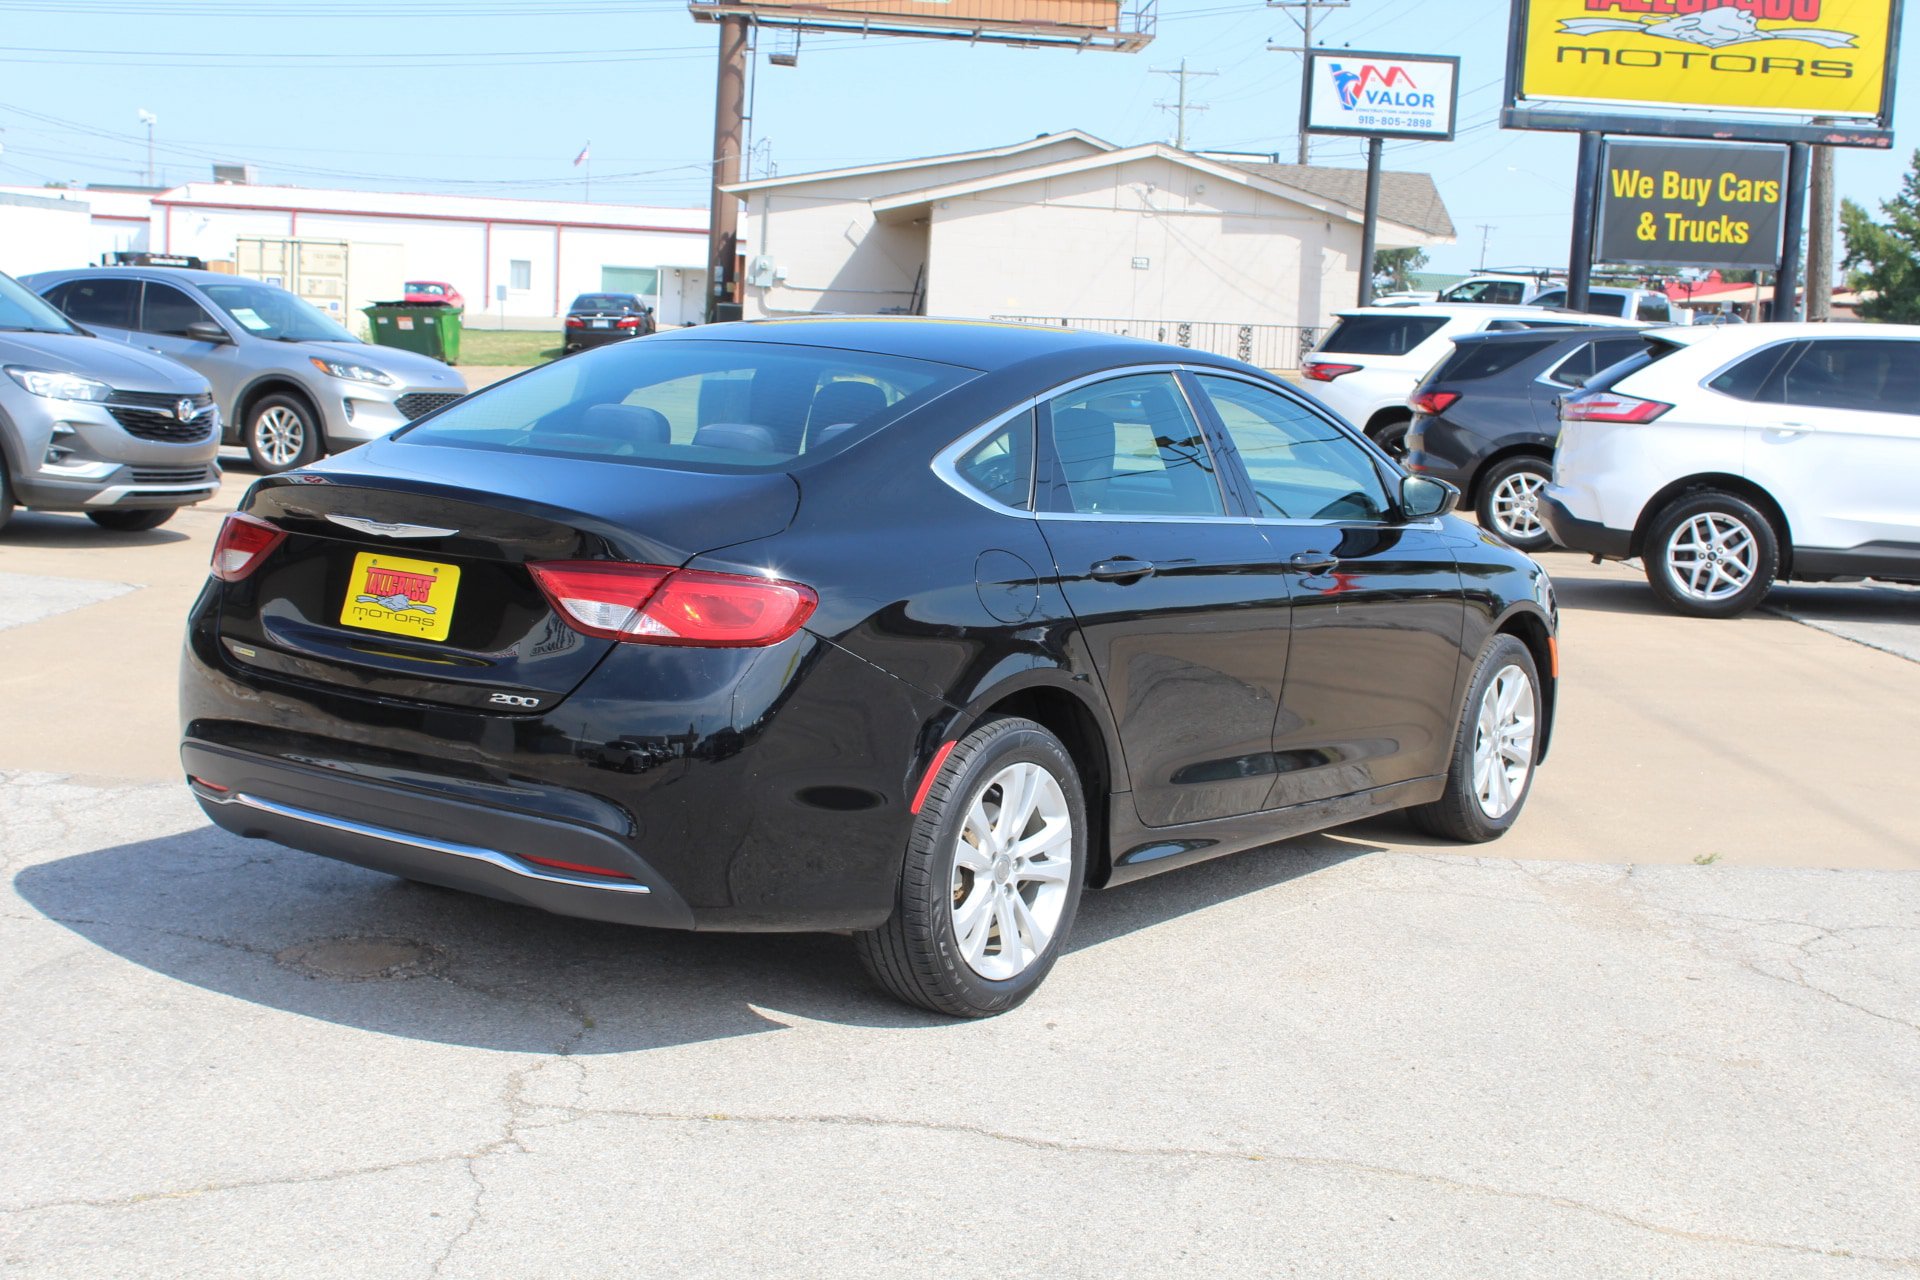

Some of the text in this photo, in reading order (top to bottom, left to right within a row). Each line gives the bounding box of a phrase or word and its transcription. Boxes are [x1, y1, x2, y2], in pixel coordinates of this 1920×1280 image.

[1557, 46, 1853, 79] MOTORS
[1366, 90, 1434, 108] VALOR
[1358, 115, 1432, 127] 918-805-2898
[1612, 169, 1779, 207] We Buy Cars
[1637, 211, 1749, 244] & Trucks
[353, 606, 435, 627] MOTORS
[489, 693, 540, 708] 200
